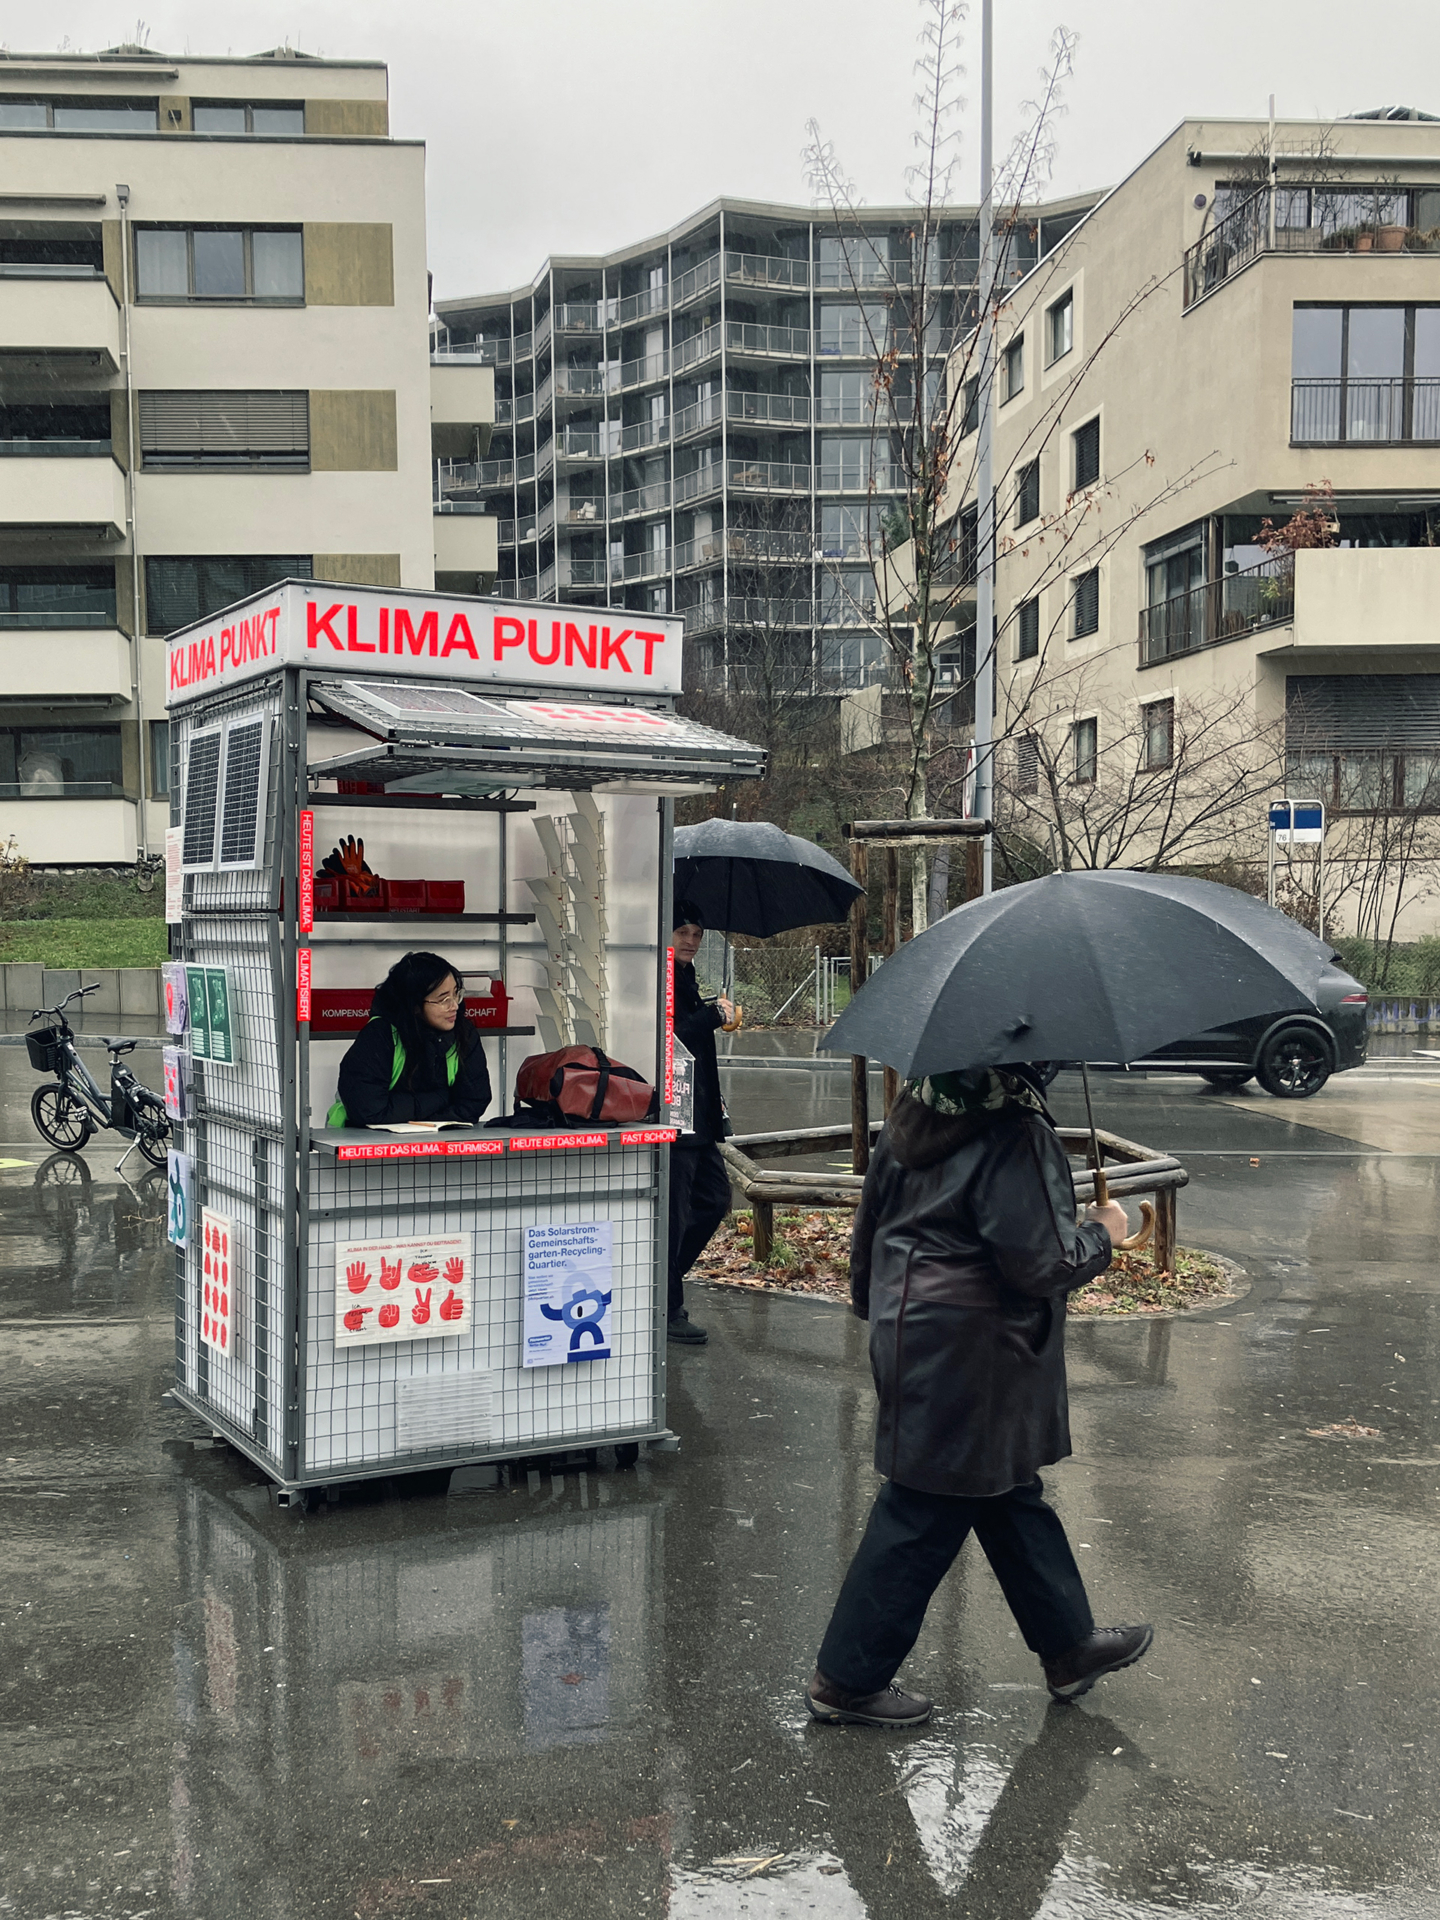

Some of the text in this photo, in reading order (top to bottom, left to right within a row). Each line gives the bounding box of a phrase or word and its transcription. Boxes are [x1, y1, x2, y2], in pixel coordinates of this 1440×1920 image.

[306, 601, 665, 676] KLIMA PUNKT
[170, 606, 281, 691] KLIMA PUNKT
[302, 814, 312, 850] HEUTE
[1278, 834, 1287, 842] 76
[302, 851, 312, 868] IST
[302, 868, 311, 891] DAS
[300, 950, 309, 1019] KLIMATISIERT
[512, 1138, 543, 1148] HEUTE
[543, 1137, 557, 1147] IST
[557, 1136, 576, 1146] DAS
[622, 1130, 675, 1143] FAST SCHÖN
[340, 1146, 373, 1158] HEUTE
[374, 1145, 389, 1156] IST
[390, 1144, 410, 1155] DAS
[447, 1141, 501, 1154] STÜRMISCH
[528, 1226, 600, 1238] Das Solarstrom-
[528, 1236, 599, 1249] Gemeinschafts-
[528, 1246, 606, 1260] garten-Recycling-
[528, 1259, 567, 1270] Quartier.
